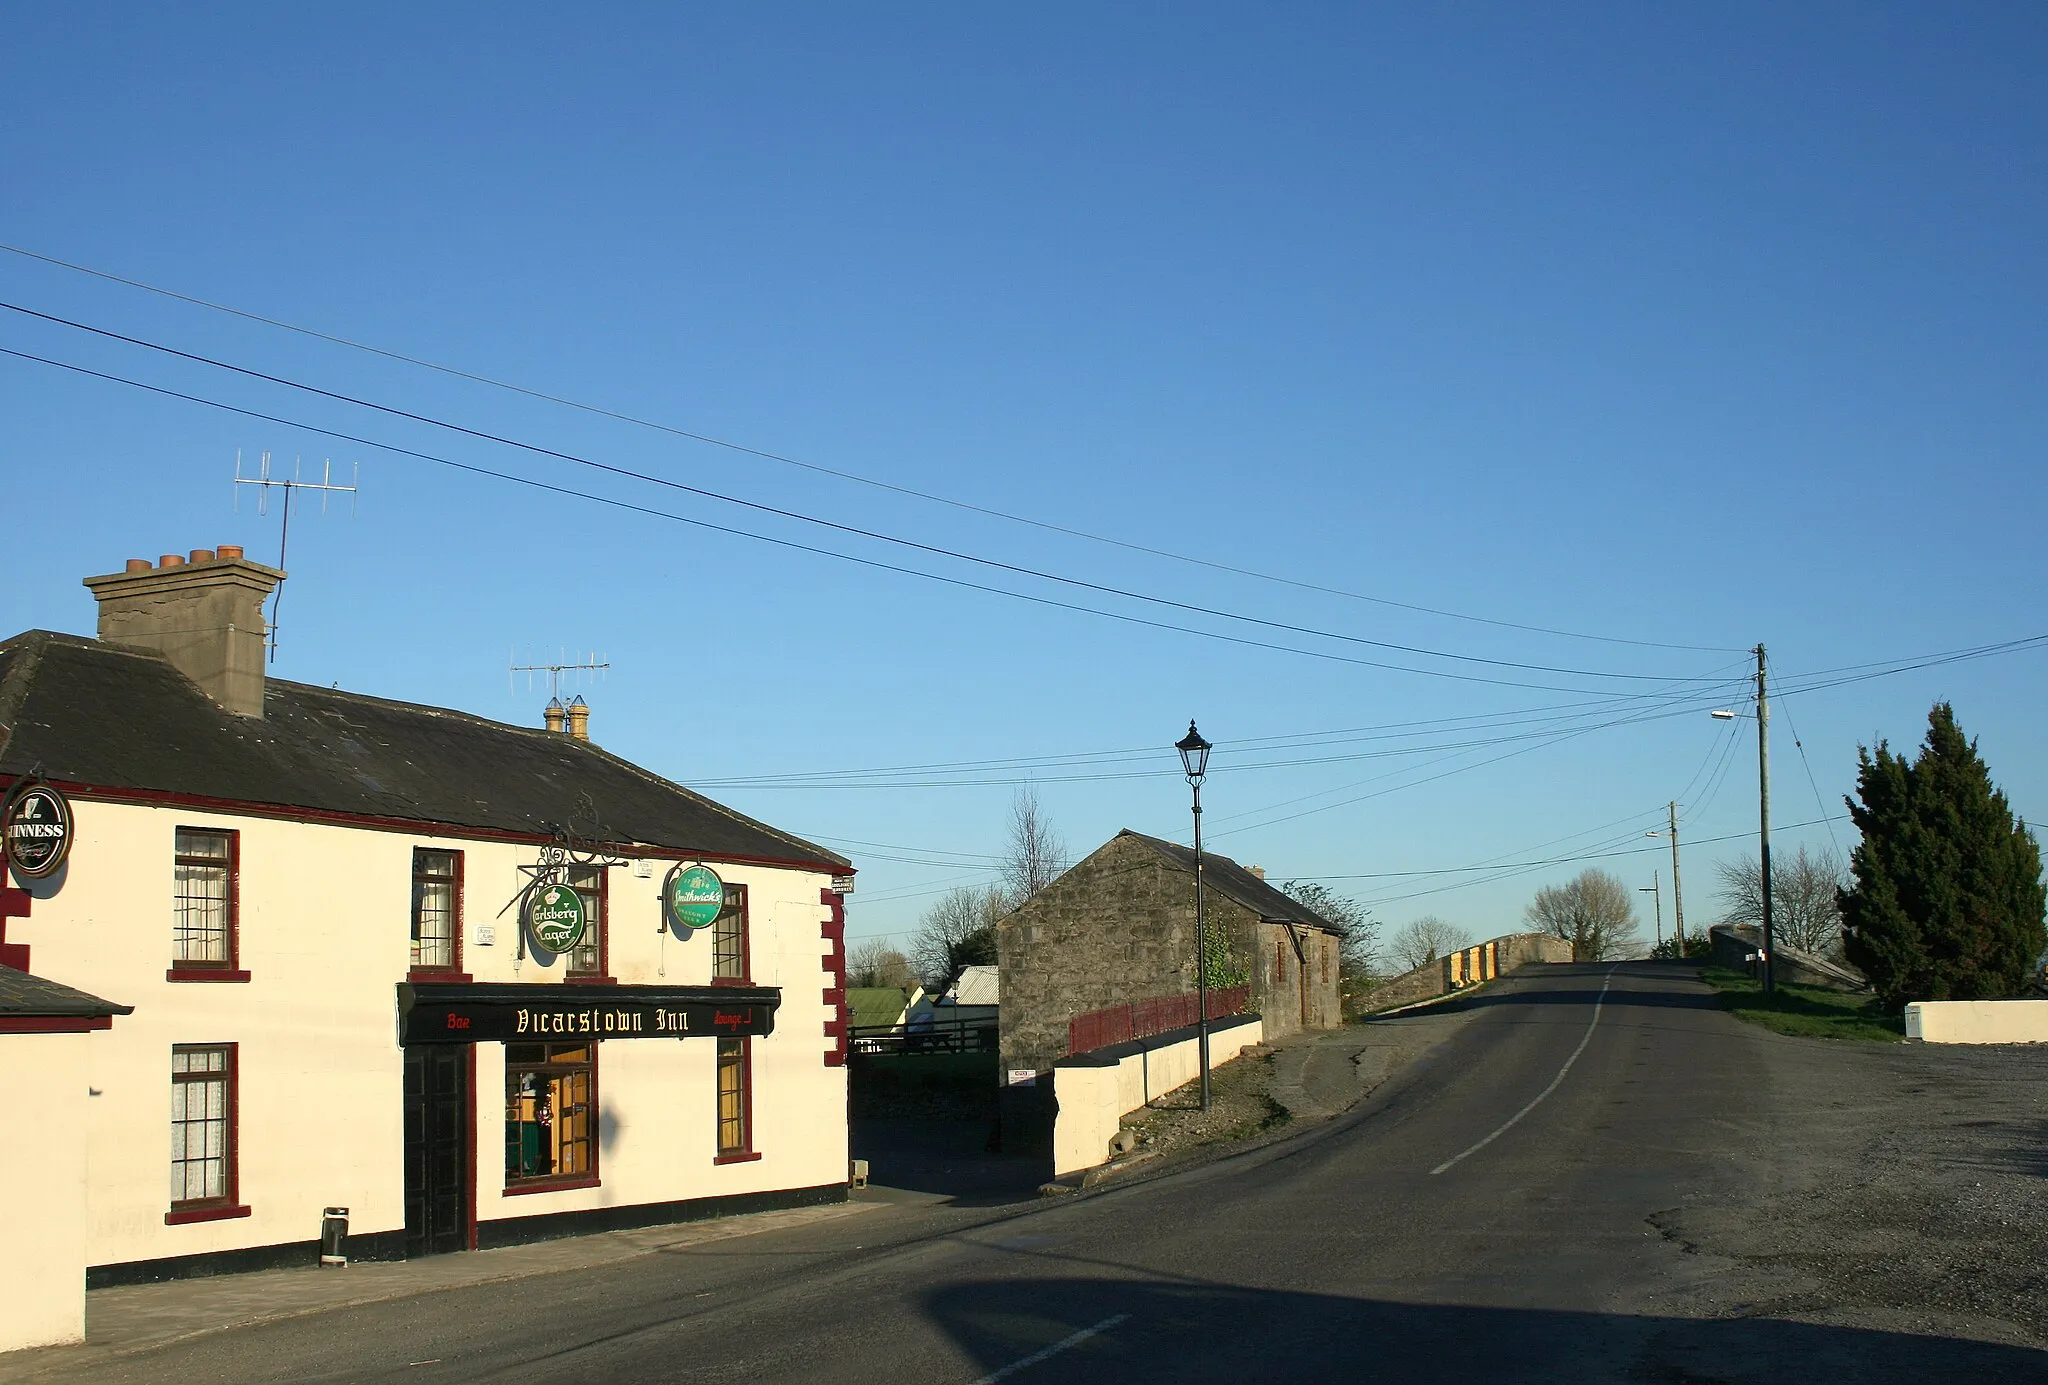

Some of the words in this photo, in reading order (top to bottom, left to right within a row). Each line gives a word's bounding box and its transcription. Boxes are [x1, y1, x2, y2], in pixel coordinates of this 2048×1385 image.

[675, 889, 721, 907] Smithwick's
[532, 904, 578, 925] Carlsberg
[539, 929, 572, 946] Lager
[516, 1008, 643, 1033] Vicarstown
[656, 1008, 689, 1031] Inn
[713, 1010, 742, 1032] Lounge
